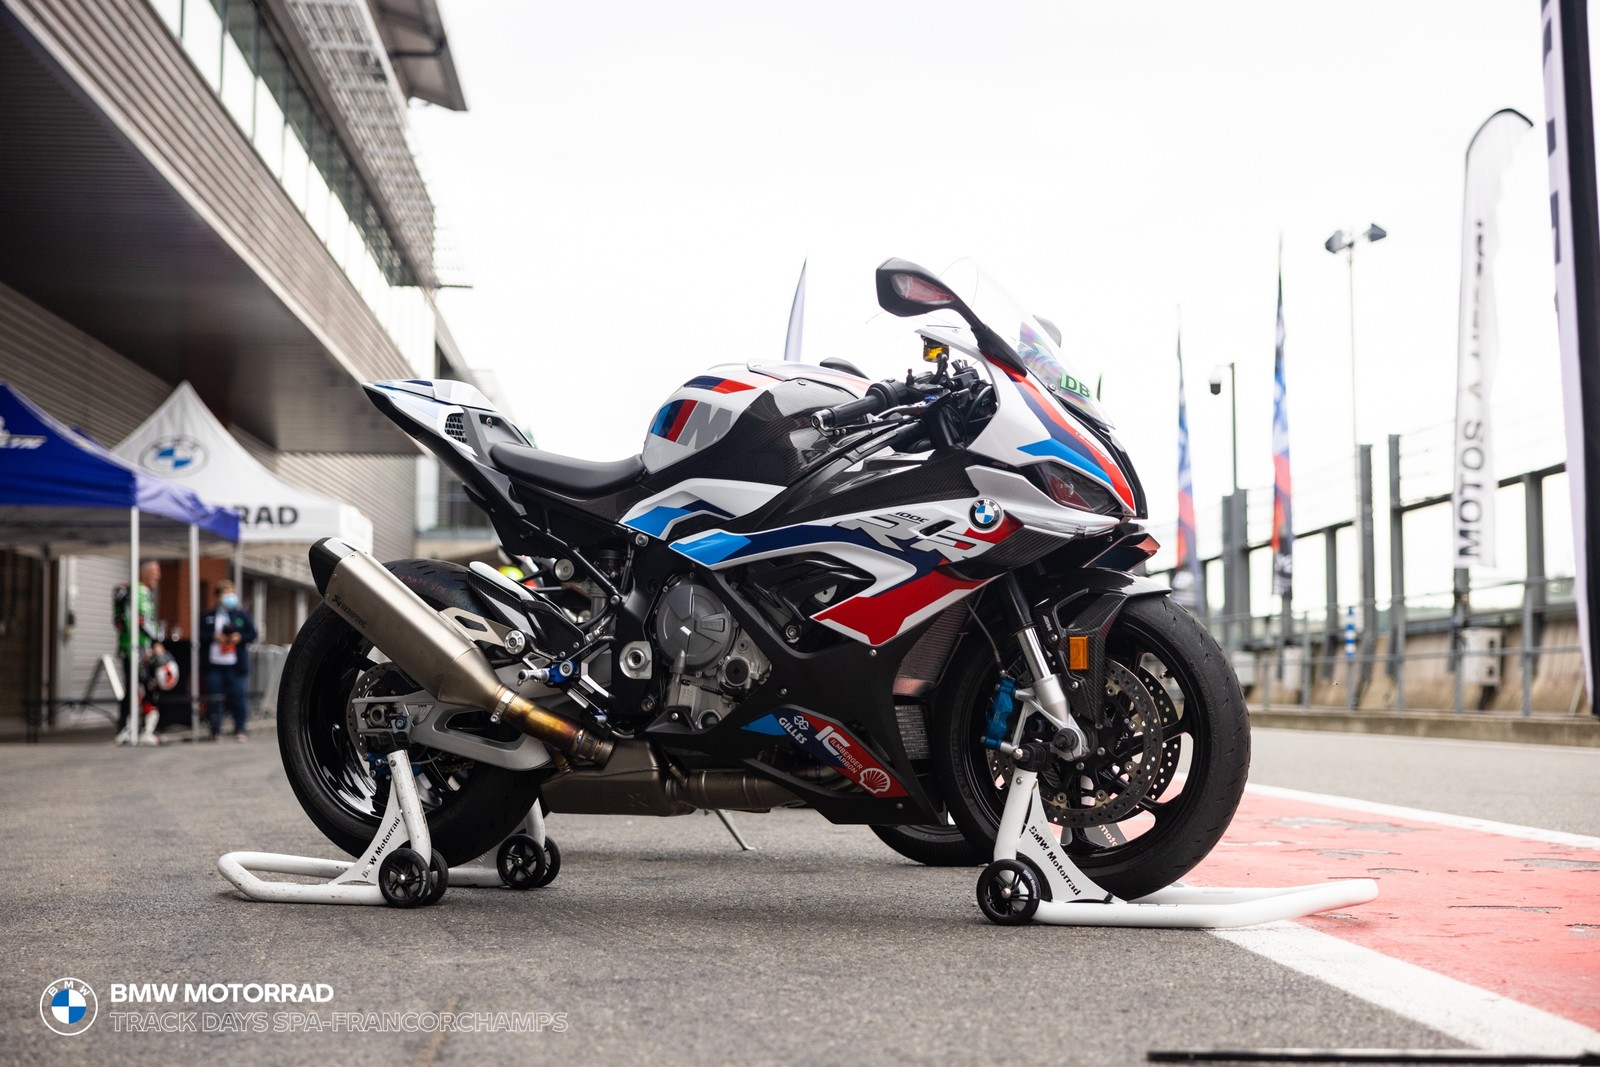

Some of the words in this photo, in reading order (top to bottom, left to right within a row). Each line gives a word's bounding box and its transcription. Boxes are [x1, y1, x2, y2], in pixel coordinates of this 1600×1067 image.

[1458, 421, 1484, 557] MOTOS
[778, 717, 808, 744] GILLES
[830, 739, 863, 769] ILMBERGER
[375, 816, 401, 857] Motorrad
[1028, 825, 1050, 850] BMW
[1047, 851, 1082, 896] Motorrad
